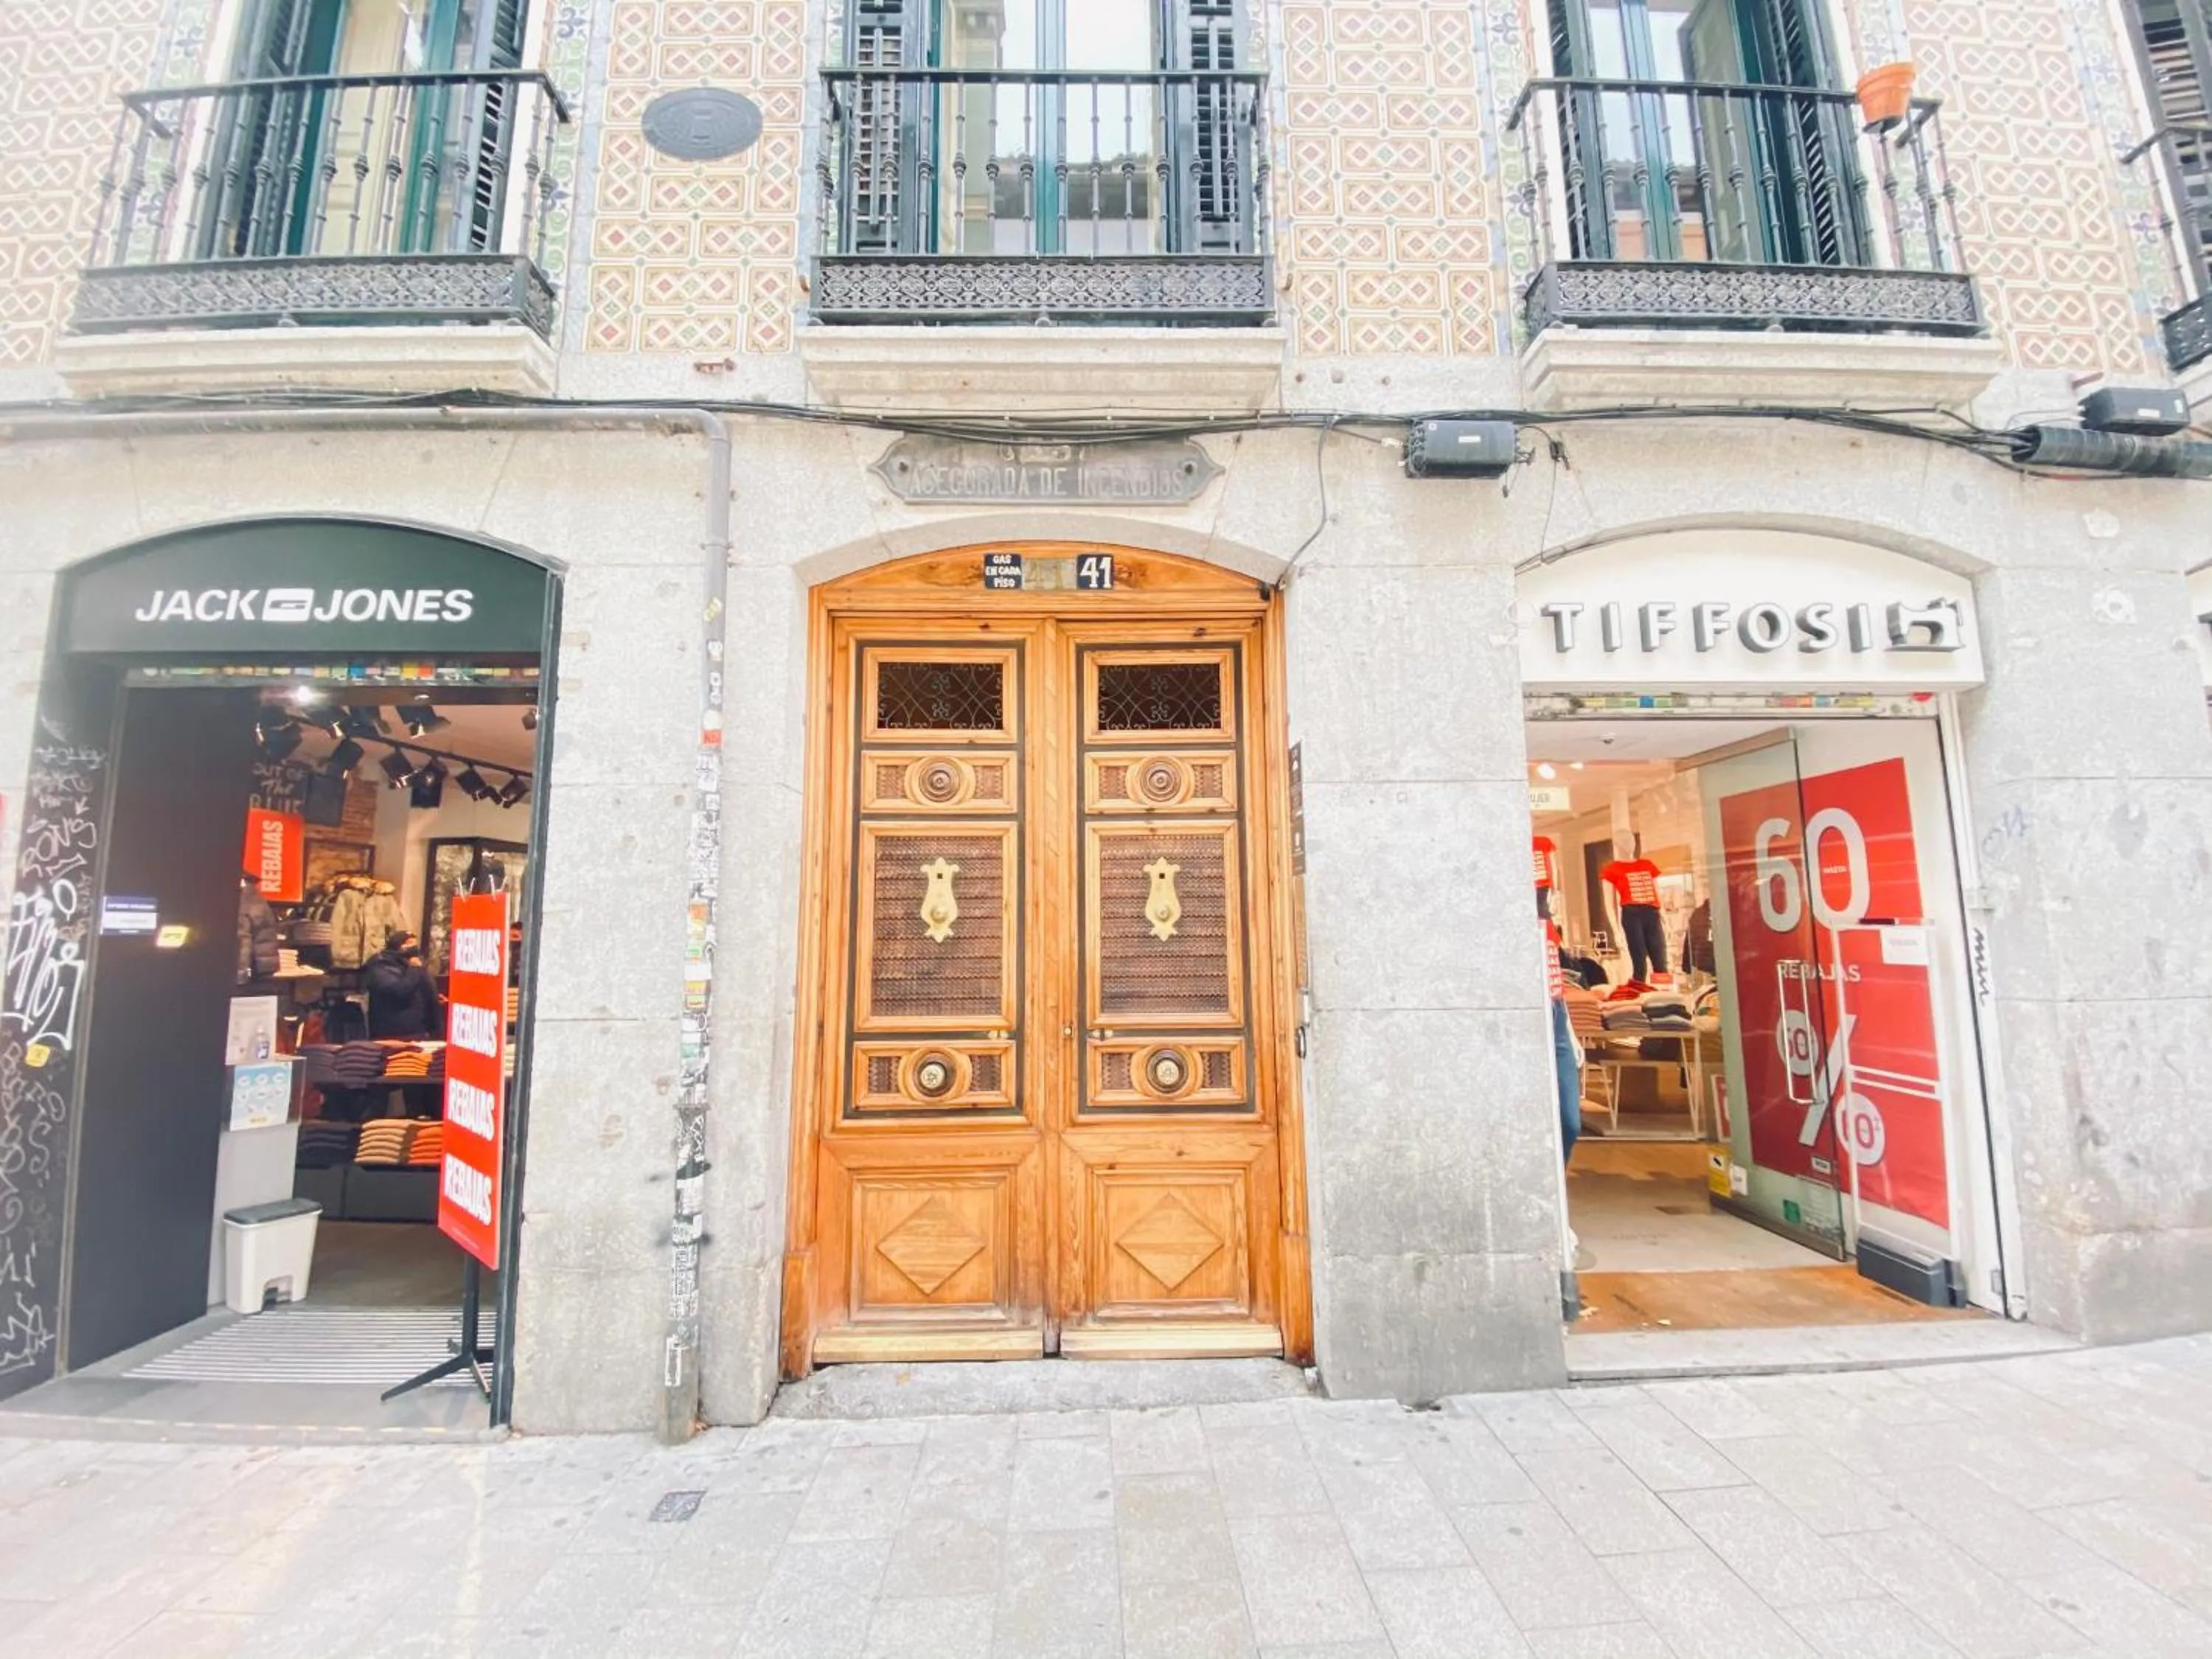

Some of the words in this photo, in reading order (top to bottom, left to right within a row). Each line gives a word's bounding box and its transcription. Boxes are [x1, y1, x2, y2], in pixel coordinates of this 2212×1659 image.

[1040, 467, 1068, 496] DE
[985, 566, 998, 575] EN
[998, 566, 1021, 575] CADA
[992, 554, 1012, 564] GAS
[1079, 557, 1113, 588] 41
[135, 589, 261, 622] JACK
[314, 588, 473, 622] JONES
[1542, 601, 1874, 653] TIFFOSI
[260, 820, 284, 893] REBAJAS
[454, 928, 501, 975] REBAJAS
[452, 1002, 498, 1058] REBAJAS
[448, 1077, 495, 1142] REBAJAS
[445, 1153, 492, 1225] REBAJAS
